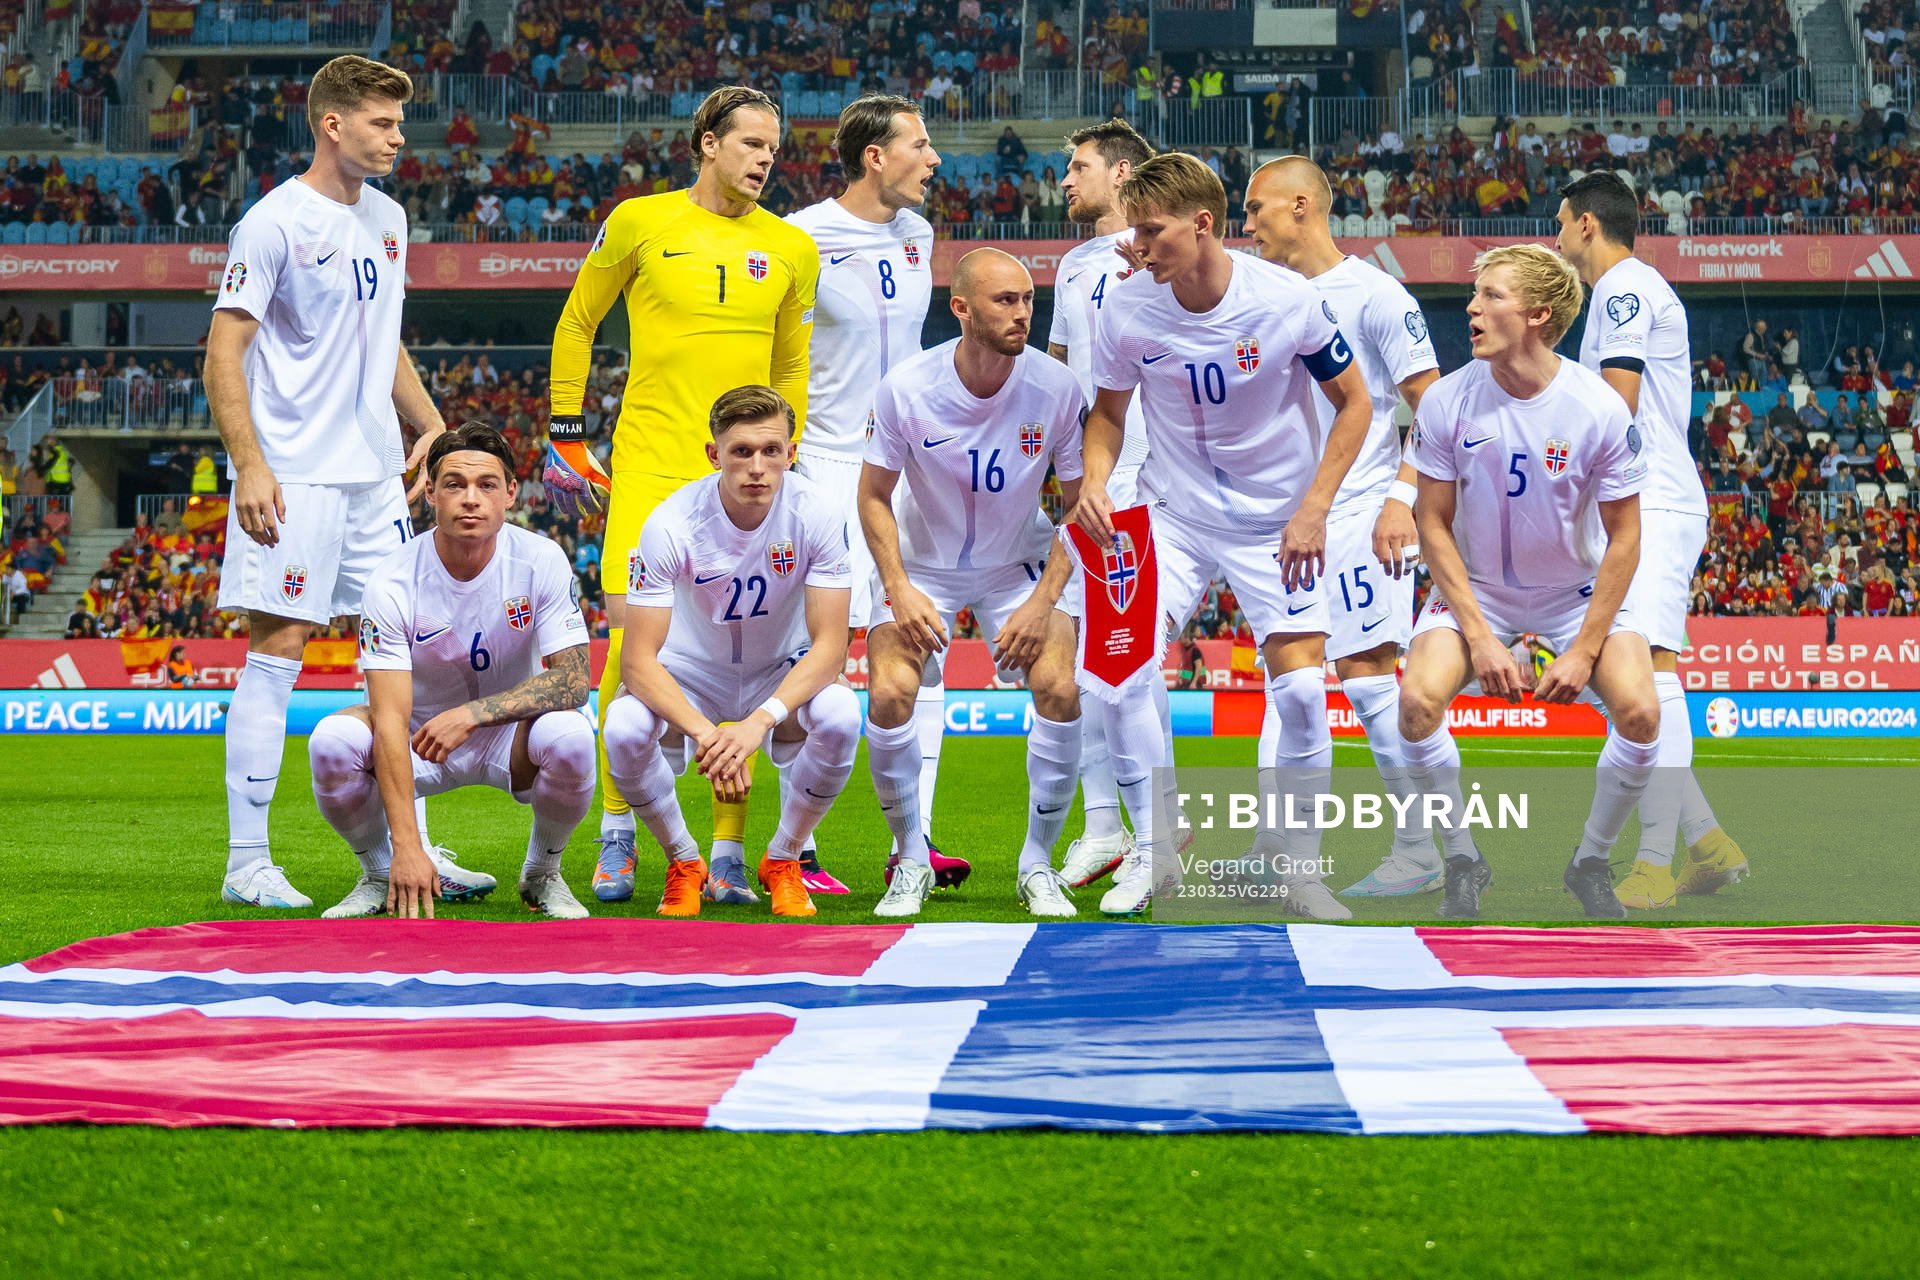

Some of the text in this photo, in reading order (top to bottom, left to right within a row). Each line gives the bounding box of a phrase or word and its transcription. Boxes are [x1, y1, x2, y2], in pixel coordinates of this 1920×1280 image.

[1244, 74, 1280, 84] SALIDA
[21, 258, 121, 274] FACTORY
[188, 247, 230, 265] fine
[1678, 239, 1784, 257] finetwork
[352, 258, 378, 301] 19
[715, 264, 726, 304] 1
[878, 259, 896, 300] 8
[1699, 261, 1763, 278] FIBRA Y MÓVIL
[1091, 273, 1108, 310] 4
[1330, 337, 1350, 364] C
[1184, 362, 1227, 405] 10
[968, 448, 1006, 494] 16
[1506, 452, 1528, 498] 5
[723, 575, 769, 621] 22
[1338, 565, 1374, 613] 15
[470, 631, 491, 672] 6
[1686, 664, 1890, 690] DE FÚTBOL
[5, 700, 110, 731] PEACE
[1444, 708, 1548, 728] UALIFIERS
